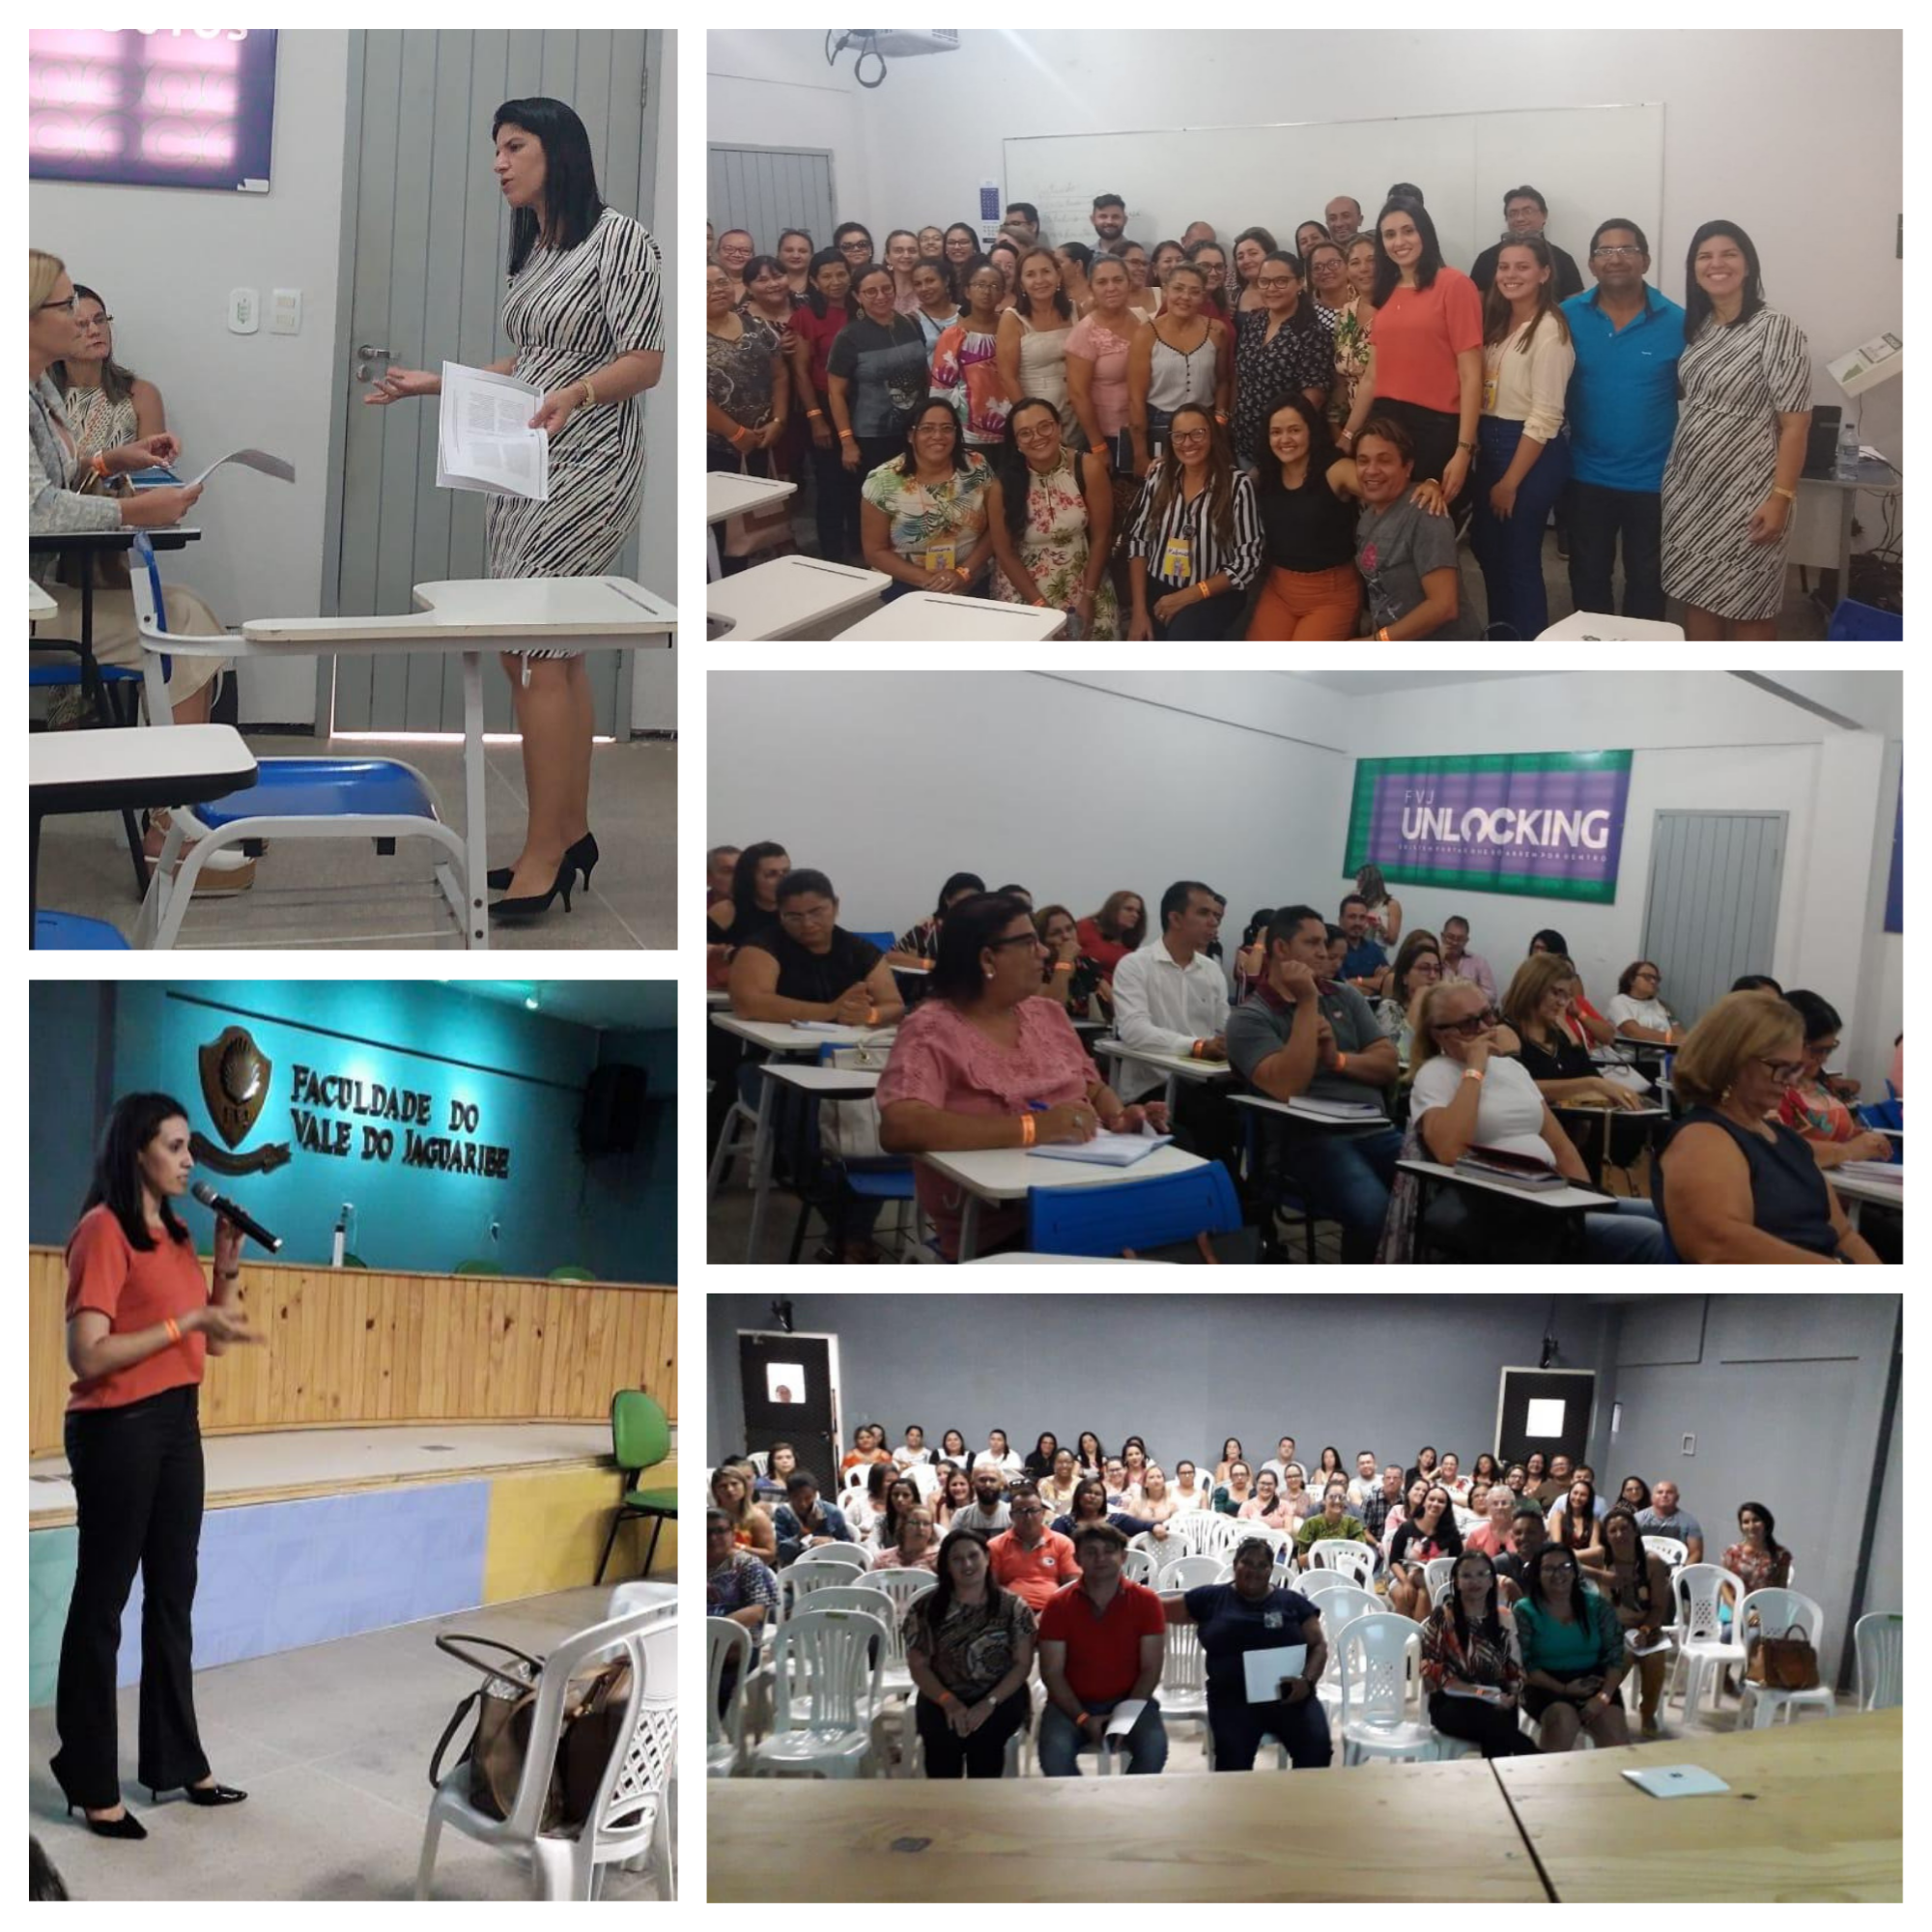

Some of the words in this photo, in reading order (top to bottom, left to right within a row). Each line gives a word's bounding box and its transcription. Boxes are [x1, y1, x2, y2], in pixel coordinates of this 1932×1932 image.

[1405, 789, 1435, 805] FVJ
[1402, 807, 1610, 849] UNLOCKING
[291, 1064, 432, 1125] FACULDADE
[448, 1099, 479, 1133] DO
[290, 1107, 352, 1157] VALE
[360, 1125, 394, 1162] DO
[402, 1128, 510, 1179] JAGUARIBE
